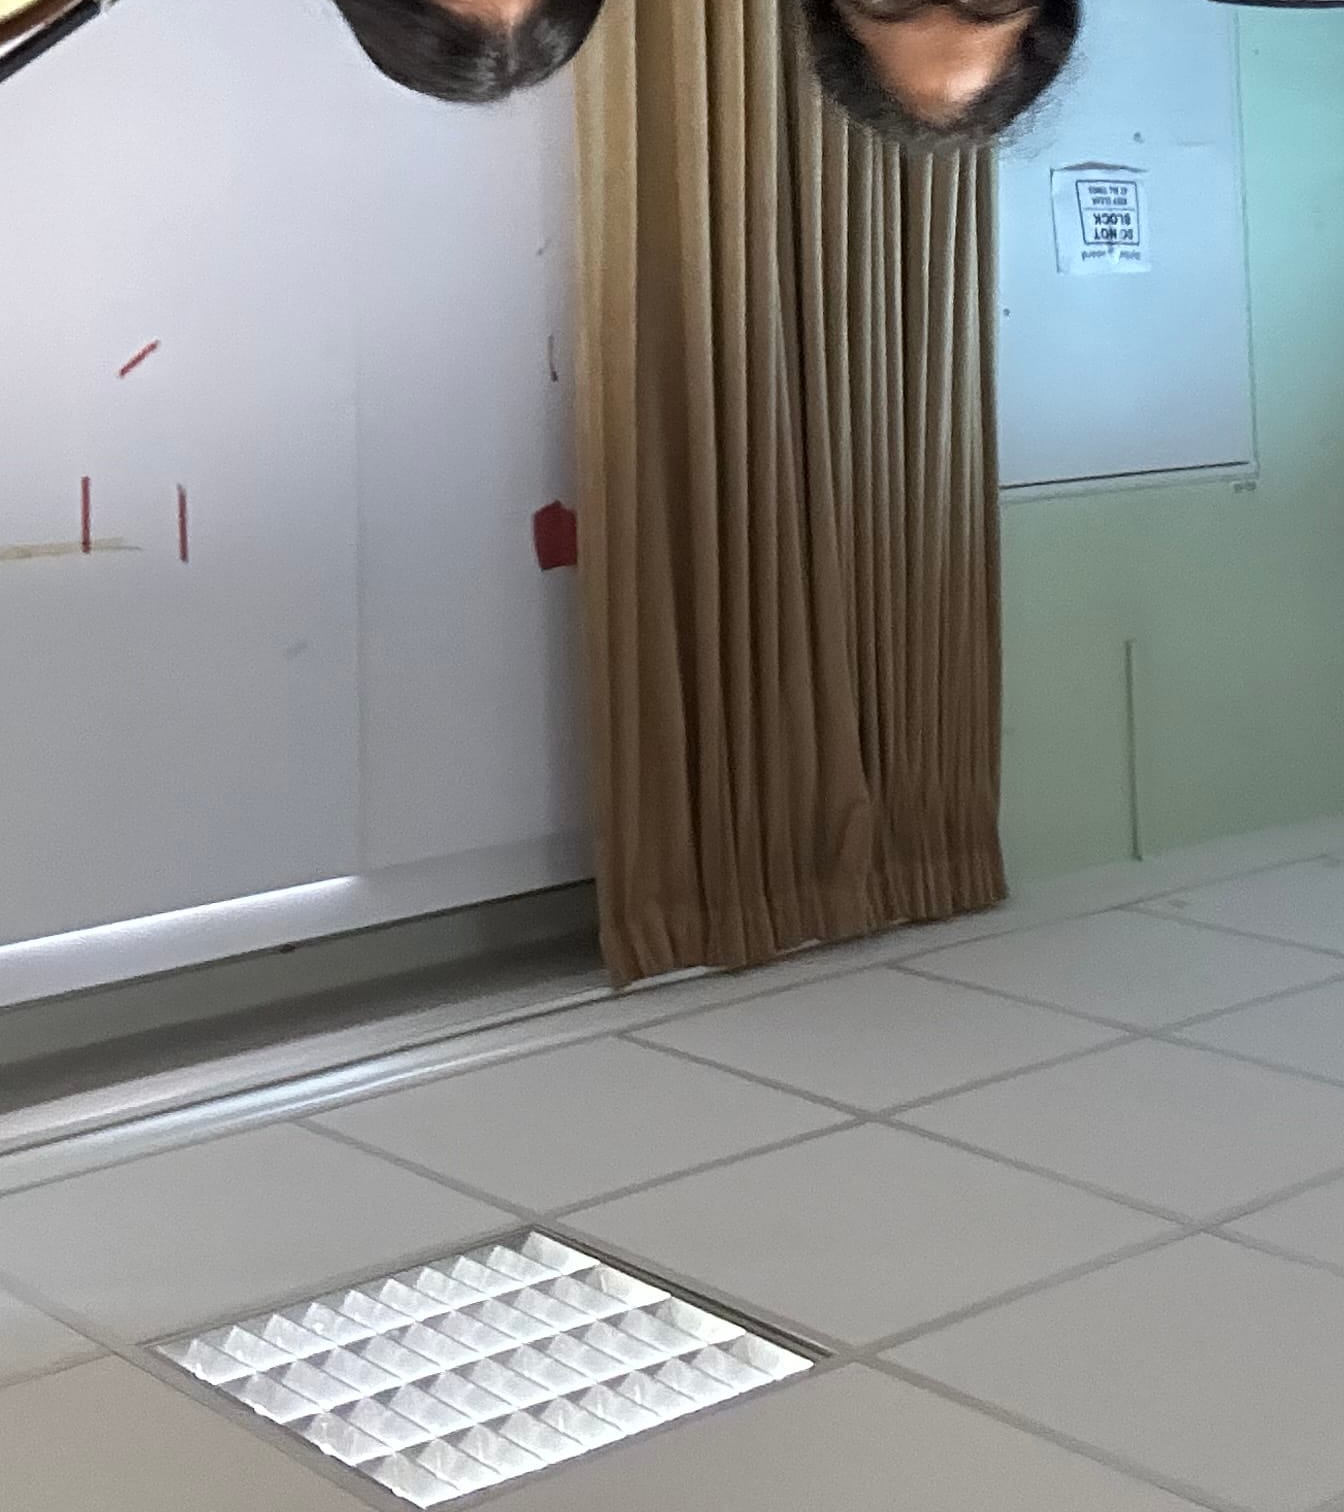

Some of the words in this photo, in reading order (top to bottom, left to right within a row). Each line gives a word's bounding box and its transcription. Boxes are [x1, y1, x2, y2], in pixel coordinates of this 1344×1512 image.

[1093, 213, 1131, 225] BLOCK
[1094, 227, 1117, 240] NOT
[1120, 229, 1133, 240] DO
